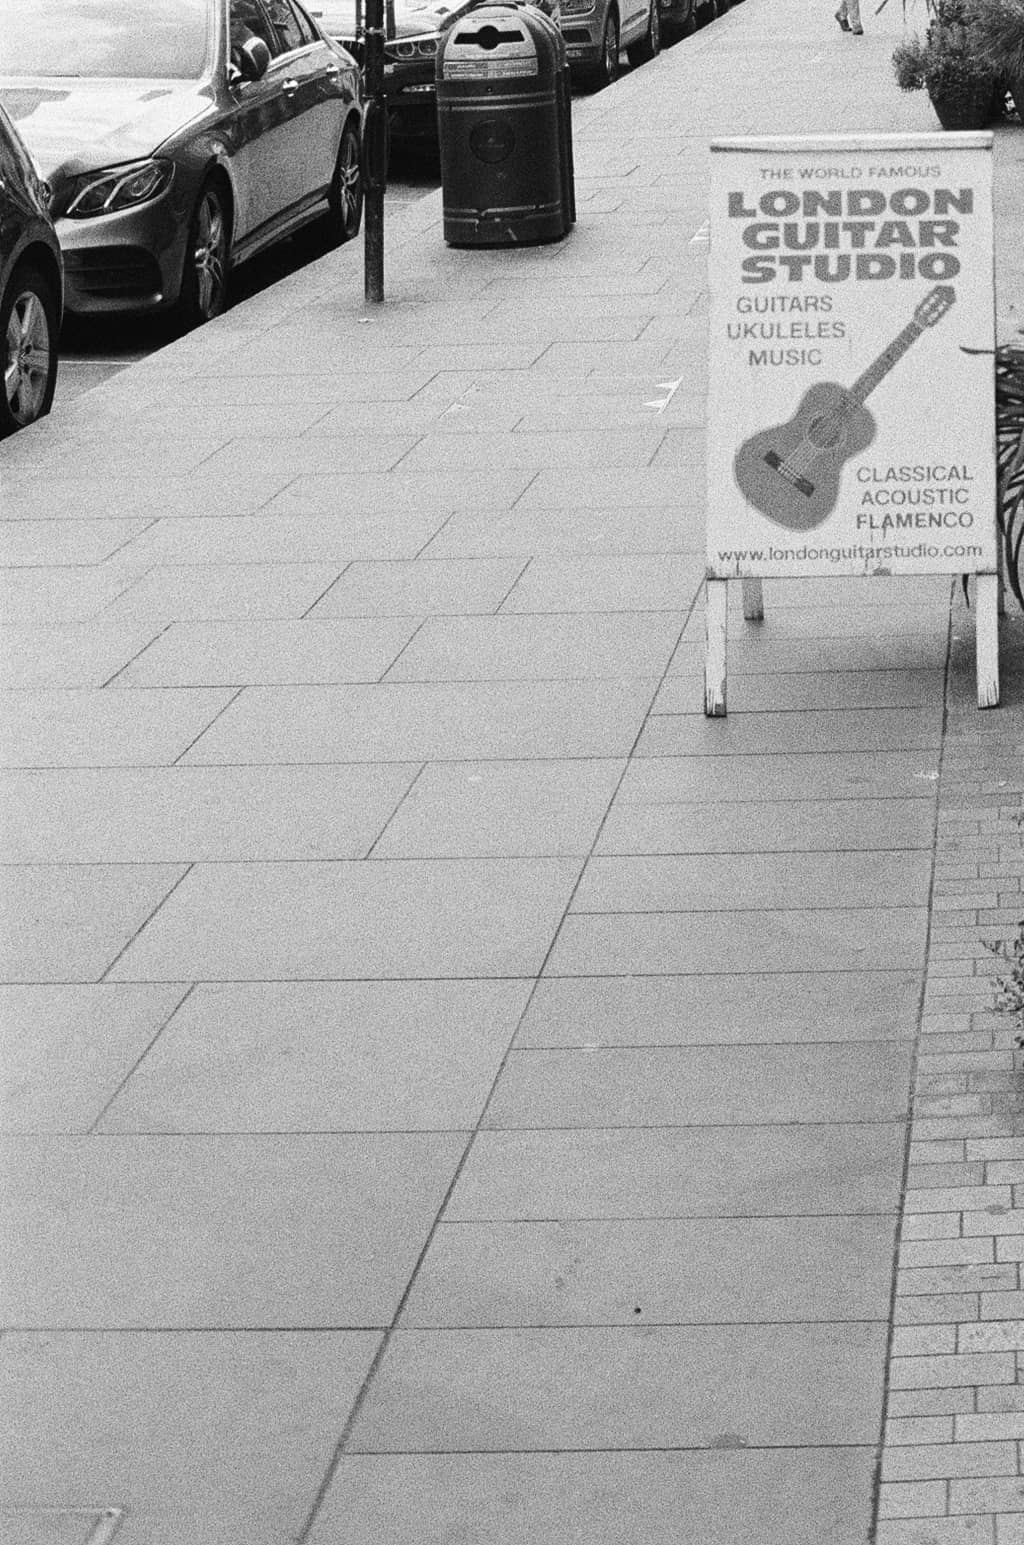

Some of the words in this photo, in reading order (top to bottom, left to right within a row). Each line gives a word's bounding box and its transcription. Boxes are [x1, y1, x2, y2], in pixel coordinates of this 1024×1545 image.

[759, 167, 793, 179] THE
[798, 165, 864, 179] WORLD
[868, 165, 942, 178] FAMOUS
[728, 188, 974, 218] LONDON
[742, 220, 960, 250] GUITAR
[741, 252, 961, 284] STUDIO
[736, 296, 833, 313] GUITARS
[726, 322, 846, 340] UKULELES
[748, 349, 822, 366] MUSIC
[857, 465, 974, 483] CLASSICAL
[861, 488, 970, 505] ACOUSTIC
[856, 512, 974, 529] FLAMENCO
[717, 543, 983, 562] www.londonguitarstudio.com
